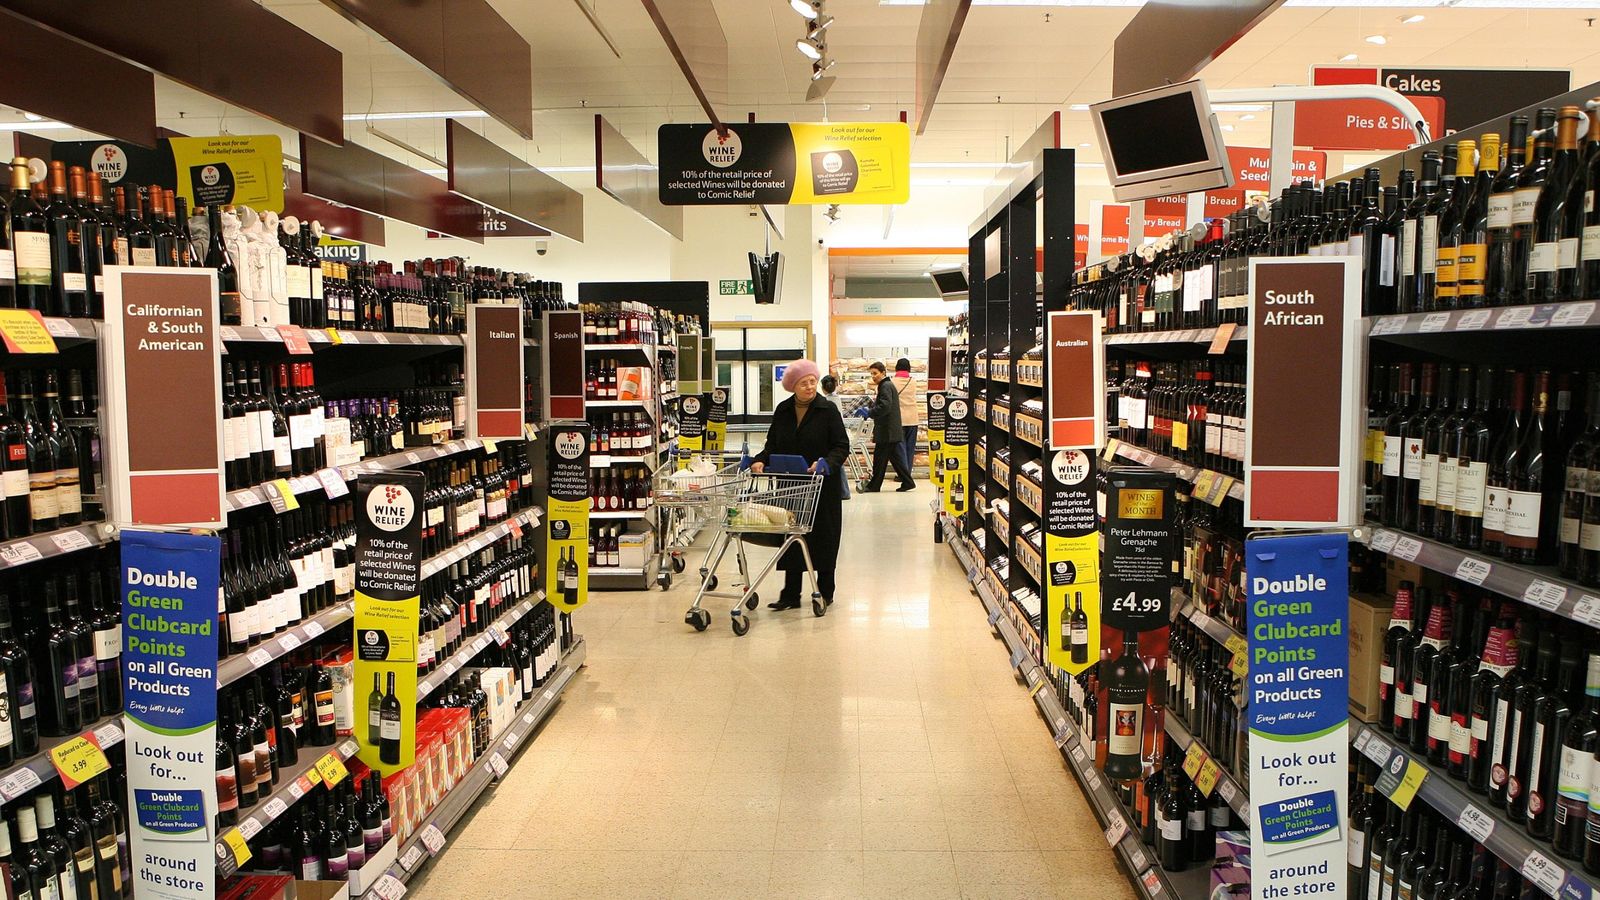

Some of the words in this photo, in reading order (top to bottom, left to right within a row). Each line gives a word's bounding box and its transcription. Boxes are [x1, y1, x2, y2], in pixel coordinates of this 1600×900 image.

[1386, 74, 1440, 91] Cakes
[1346, 115, 1374, 129] Pies
[1378, 116, 1388, 129] &
[1308, 161, 1316, 171] &
[744, 171, 762, 179] price
[764, 170, 772, 178] of
[1292, 174, 1315, 183] read
[752, 180, 785, 188] donated
[1211, 196, 1237, 205] Bread
[314, 246, 359, 260] aking
[1265, 290, 1314, 305] South
[127, 303, 203, 318] Californian
[1264, 312, 1324, 326] African
[148, 322, 158, 334] &
[162, 321, 203, 334] South
[490, 331, 515, 339] Italian
[554, 332, 578, 340] Spanish
[138, 338, 204, 351] American
[375, 505, 405, 516] WINE
[376, 517, 405, 525] RELIEF
[1111, 528, 1130, 536] Peter
[370, 539, 385, 548] 10%
[396, 541, 408, 549] the
[1121, 538, 1157, 546] Grenache
[364, 550, 383, 558] retail
[385, 552, 403, 560] price
[360, 560, 391, 569] selected
[393, 563, 416, 571] Wines
[128, 567, 197, 589] Double
[384, 572, 416, 581] donated
[369, 581, 393, 590] Comic
[394, 582, 416, 591] Relief
[1253, 574, 1326, 594] Double
[128, 590, 183, 610] Green
[1112, 592, 1161, 612] £4.99
[1254, 600, 1312, 617] Green
[128, 614, 211, 635] Clubcard
[1254, 619, 1341, 640] Clubcard
[129, 636, 185, 657] Points
[1255, 646, 1316, 664] Points
[128, 661, 144, 672] on
[149, 661, 164, 674] all
[168, 662, 211, 678] Green
[1255, 673, 1273, 684] on
[1277, 668, 1294, 682] all
[1298, 667, 1343, 681] Green
[129, 677, 190, 696] Products
[1256, 688, 1321, 703] Products
[130, 701, 147, 713] Every
[150, 704, 165, 712] little
[167, 705, 184, 714] helps
[1256, 714, 1276, 724] Every
[1279, 713, 1295, 721] little
[1298, 711, 1316, 719] helps
[58, 748, 75, 757] Reduced
[135, 742, 171, 760] Look
[177, 751, 204, 763] out
[1262, 753, 1302, 769] Look
[1308, 752, 1336, 765] out
[150, 763, 186, 781] for...
[1279, 773, 1318, 786] for...
[152, 793, 182, 801] Double
[140, 802, 161, 810] Green
[163, 803, 199, 811] Clubcard
[1280, 798, 1314, 812] Double
[157, 812, 182, 820] Points
[1265, 814, 1290, 825] Green
[1293, 804, 1332, 819] Clubcard
[1286, 818, 1313, 830] Points
[1288, 828, 1304, 837] Green
[1305, 823, 1330, 833] Products
[146, 854, 196, 872] around
[1270, 860, 1328, 879] around
[140, 868, 161, 884] the
[166, 875, 204, 892] store
[1263, 885, 1288, 899] the
[1294, 881, 1336, 895] store
